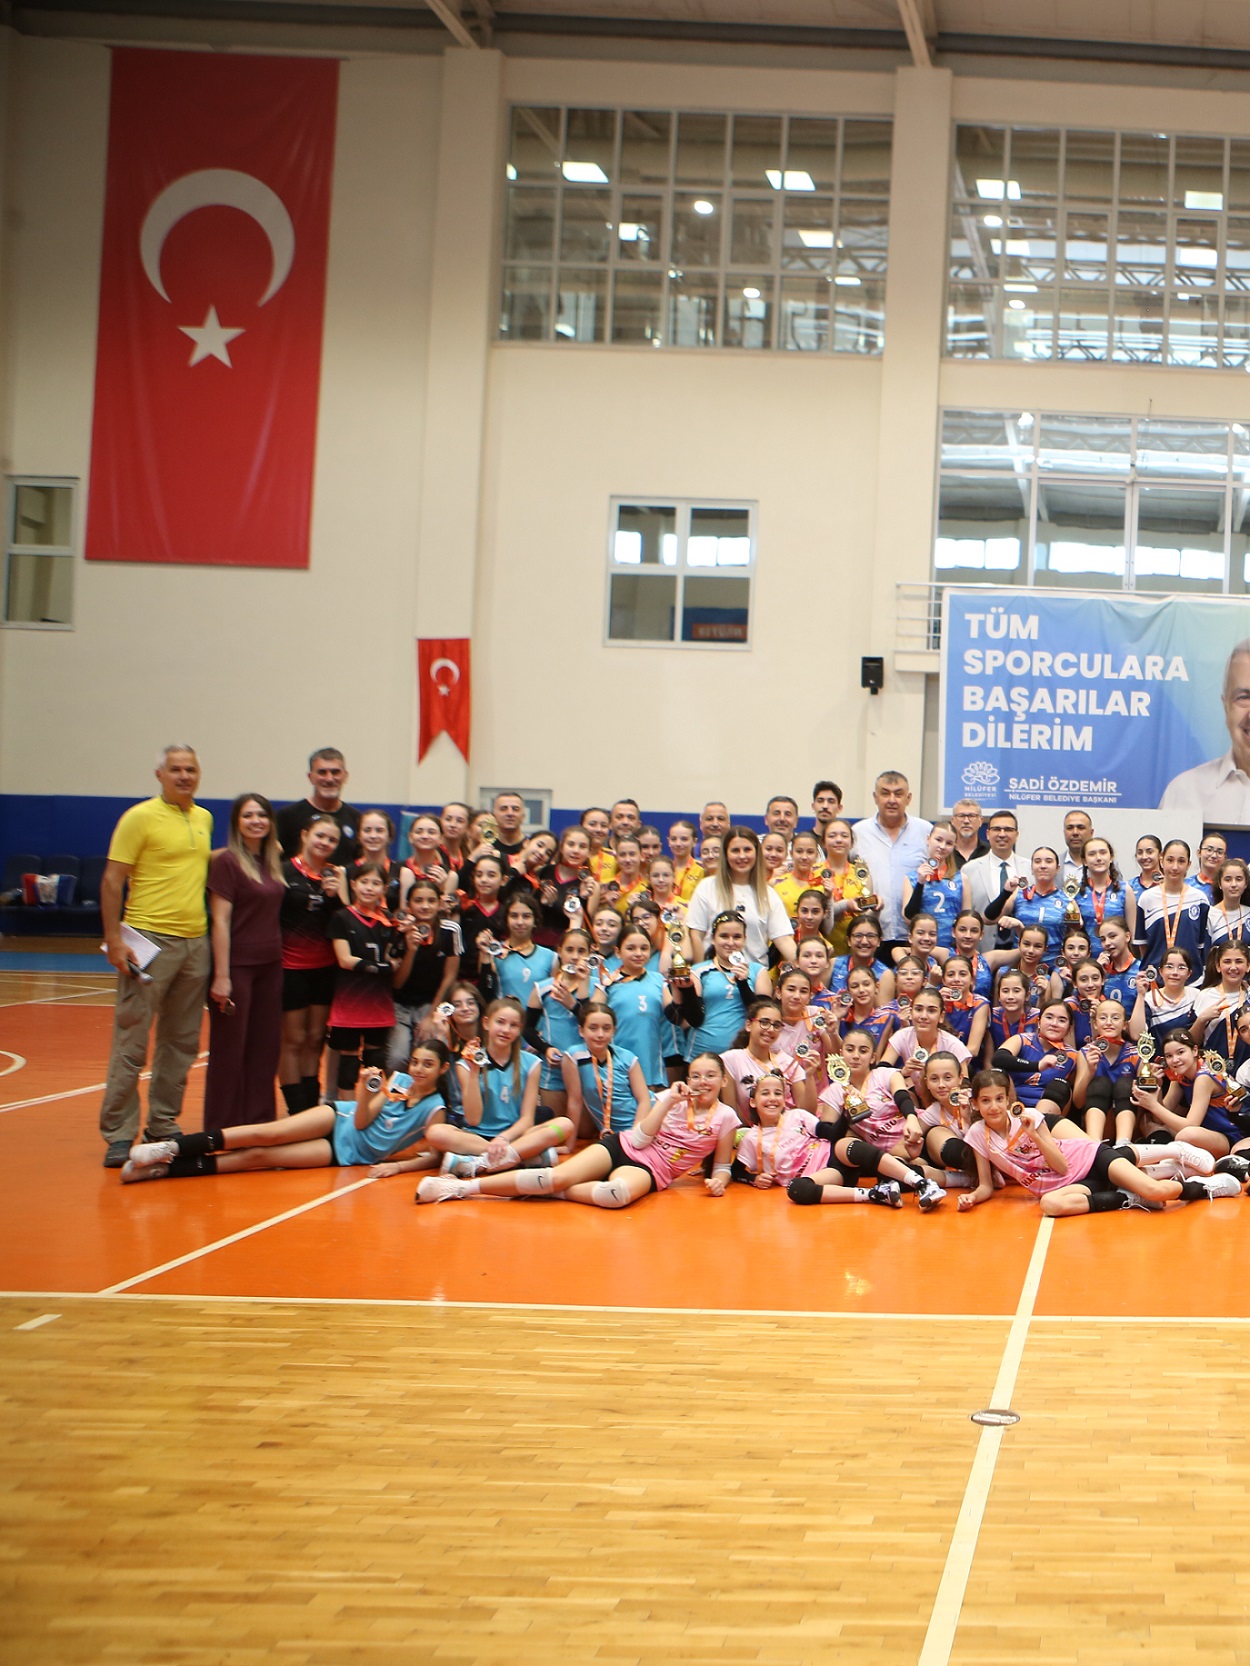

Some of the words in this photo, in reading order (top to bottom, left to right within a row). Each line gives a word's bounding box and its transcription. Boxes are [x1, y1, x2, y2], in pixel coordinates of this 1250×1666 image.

[964, 606, 1039, 640] TÜM
[963, 649, 1189, 681] SPORCULARA
[962, 685, 1151, 721] BAŞARILAR
[962, 715, 1093, 751] DİLERİM
[1009, 776, 1044, 793] ŞADİ
[1047, 777, 1117, 792] ÖZDEMİR
[1008, 793, 1041, 801] NİLÜFER
[1043, 795, 1081, 803] BELEDİYE
[931, 892, 946, 913] 2
[522, 968, 531, 983] 9
[725, 983, 735, 999] 2
[637, 995, 647, 1012] 3
[500, 1085, 509, 1104] 4
